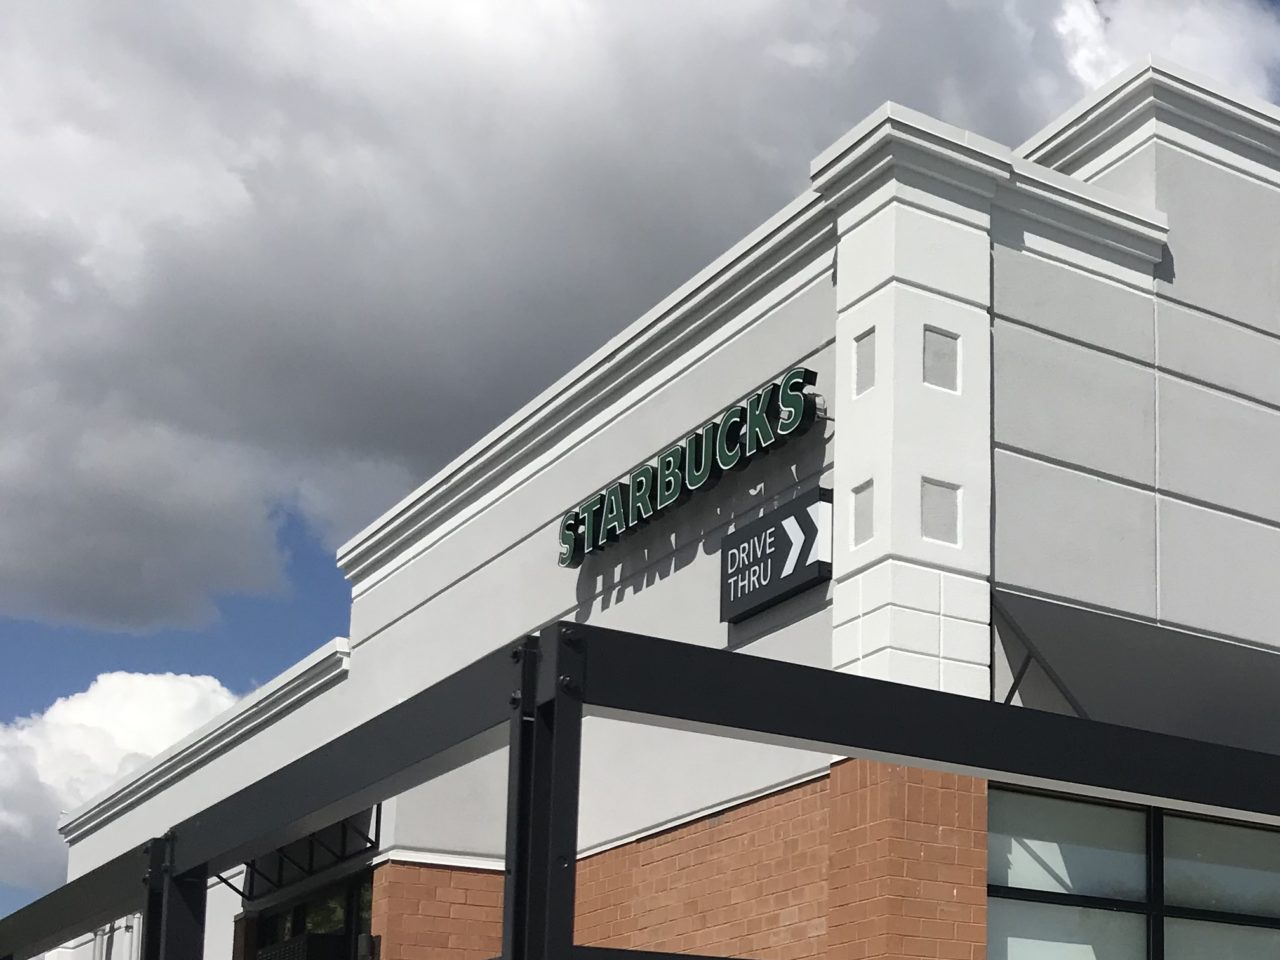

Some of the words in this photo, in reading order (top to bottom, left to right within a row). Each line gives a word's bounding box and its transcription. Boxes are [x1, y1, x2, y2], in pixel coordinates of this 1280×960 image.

[558, 366, 817, 569] STARBUCKS
[726, 526, 776, 575] DRIVE
[726, 558, 772, 602] THRU
